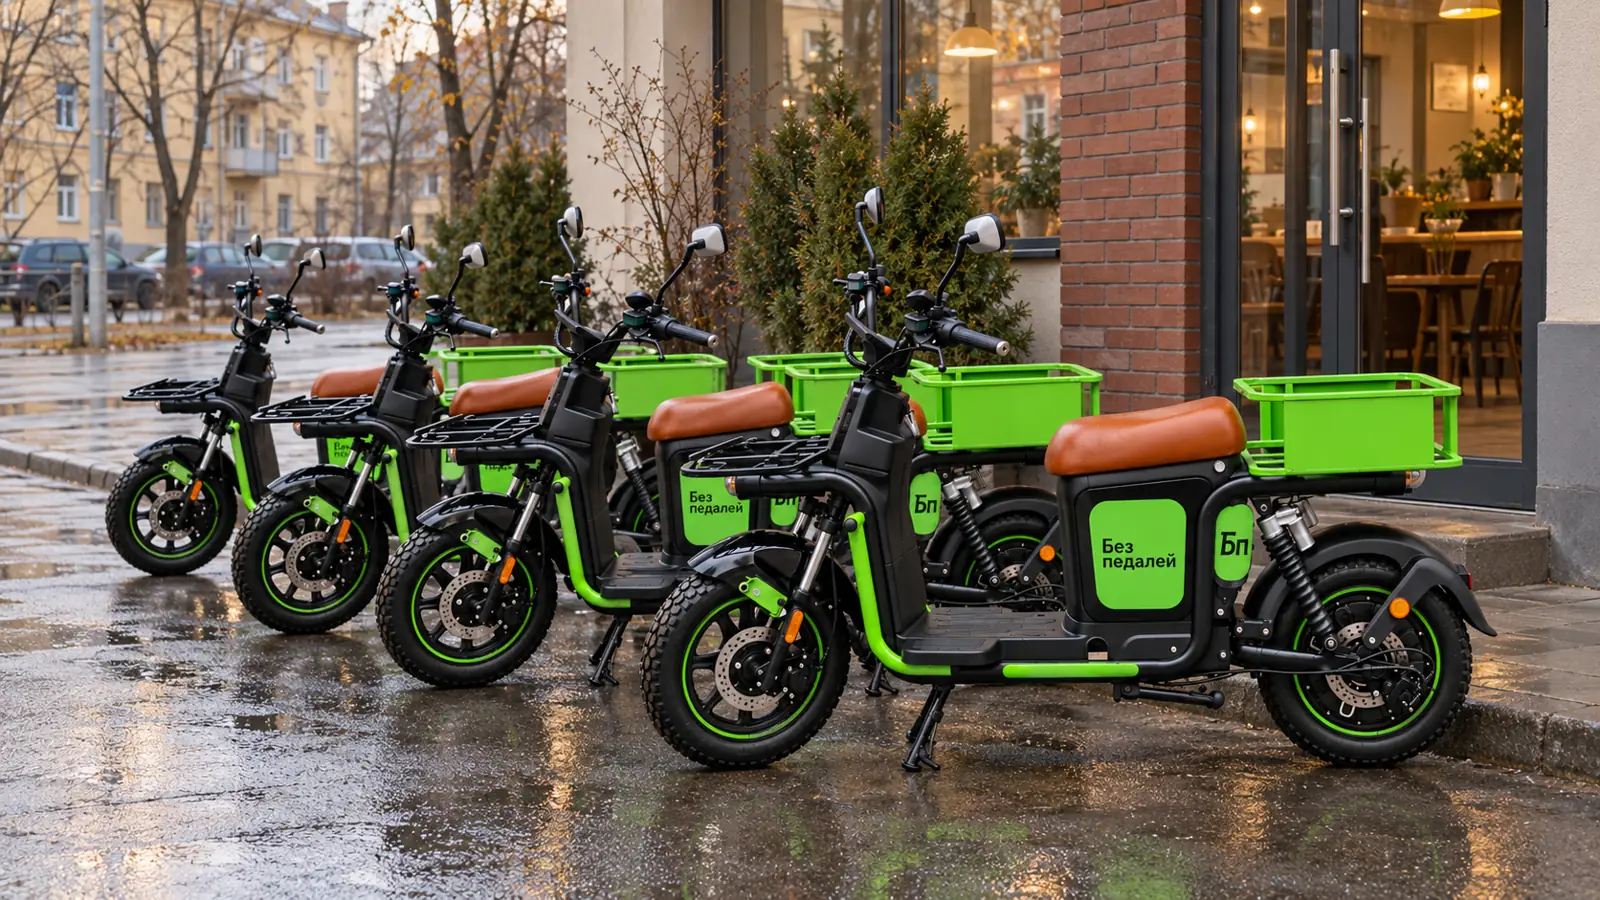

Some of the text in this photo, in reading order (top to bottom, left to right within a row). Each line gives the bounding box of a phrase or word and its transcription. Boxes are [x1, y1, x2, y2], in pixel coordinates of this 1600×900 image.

[689, 490, 713, 503] Без
[914, 494, 938, 514] Бп
[689, 502, 743, 516] педалей
[1102, 538, 1134, 554] Без
[1220, 531, 1249, 556] Бп
[1102, 553, 1176, 570] педалей
